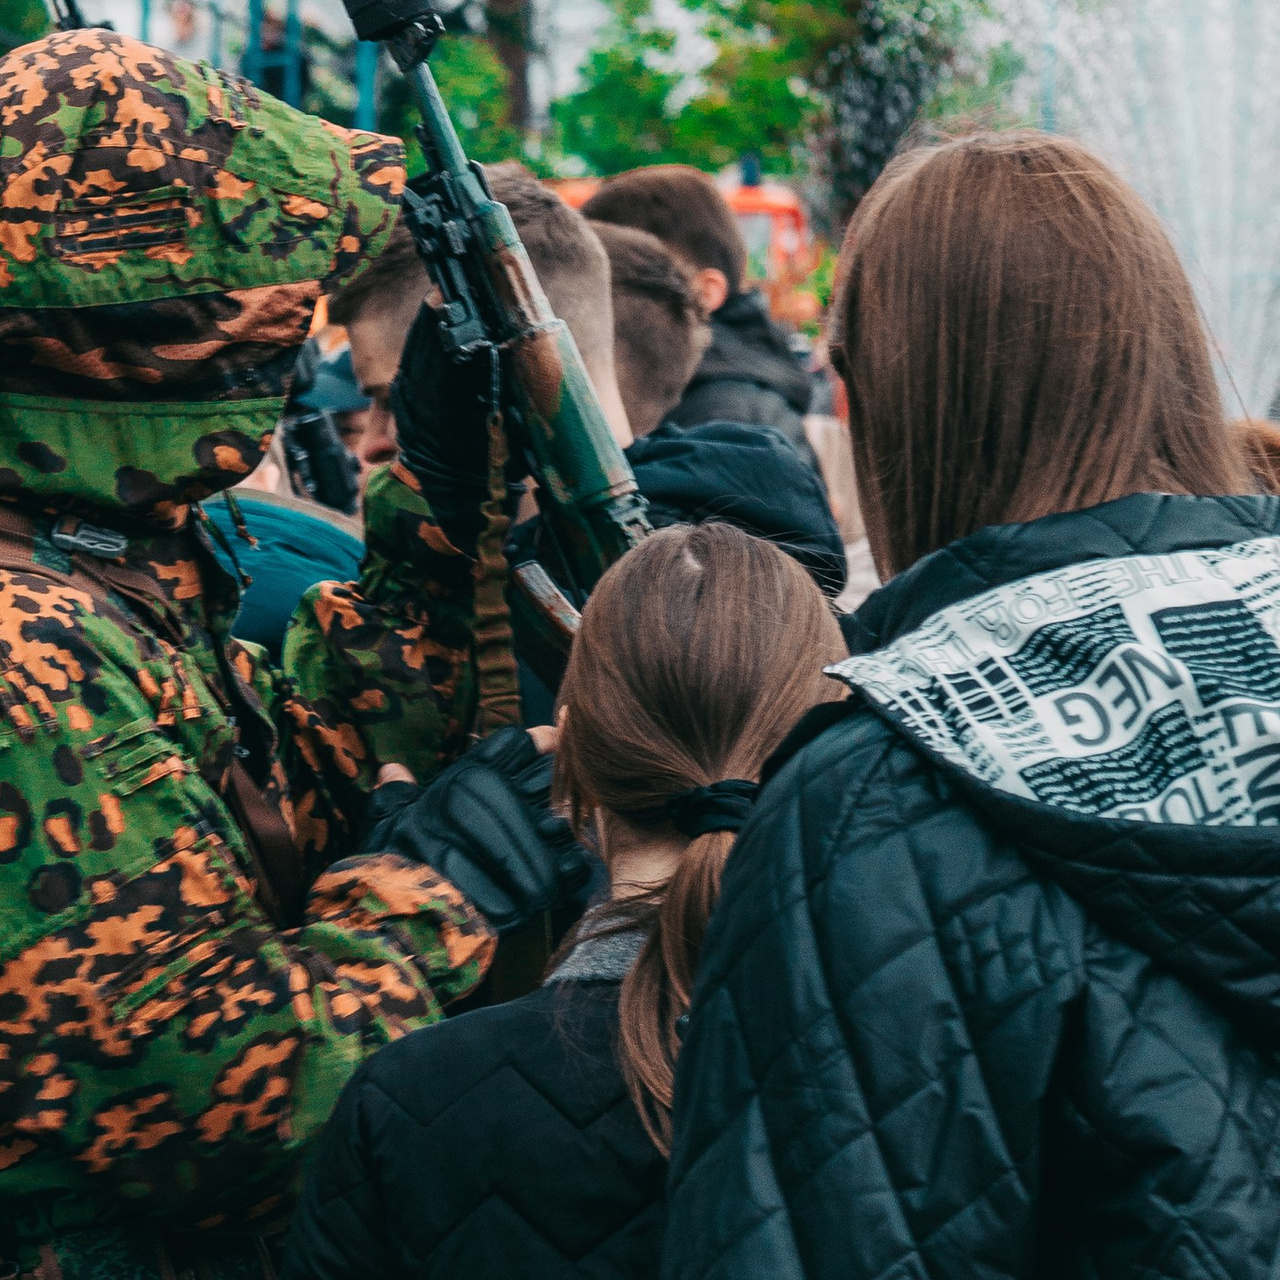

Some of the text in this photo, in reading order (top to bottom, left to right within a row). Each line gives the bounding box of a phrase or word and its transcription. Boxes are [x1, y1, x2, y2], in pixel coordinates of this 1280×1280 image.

[1116, 557, 1202, 598] THE
[976, 580, 1077, 645] FOR
[1054, 648, 1183, 747] NEG
